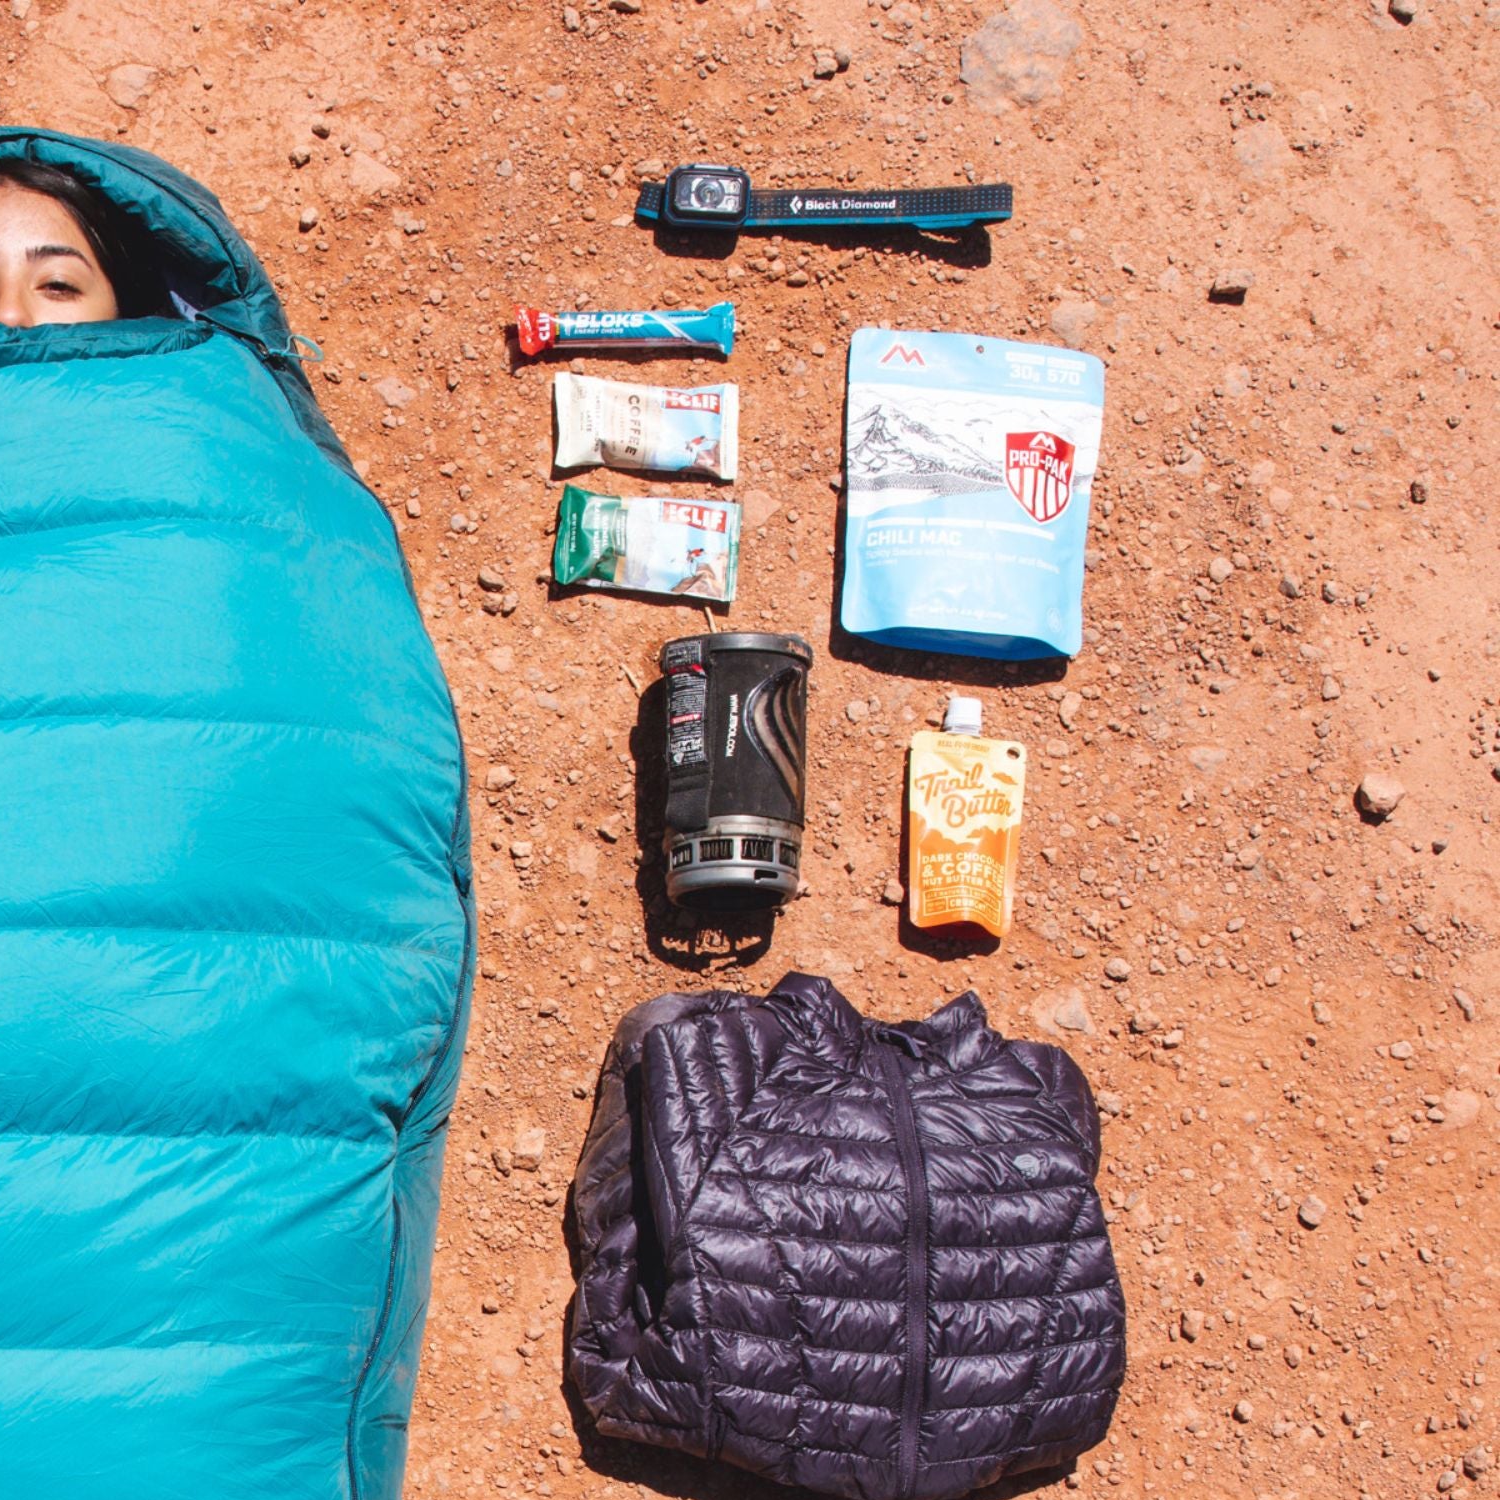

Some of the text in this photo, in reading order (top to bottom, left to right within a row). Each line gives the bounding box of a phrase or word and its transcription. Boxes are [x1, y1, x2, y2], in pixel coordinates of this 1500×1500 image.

[805, 199, 896, 210] Black Diamond
[574, 313, 645, 328] BLOKS
[1046, 367, 1080, 385] 570
[679, 394, 718, 410] CLIF
[625, 394, 642, 456] COFFEE
[1008, 449, 1070, 484] PRO-PAK
[677, 505, 723, 531] CLIF
[866, 529, 962, 547] CHILI MAC
[914, 762, 985, 807] Trail
[941, 789, 1016, 828] Butter
[921, 852, 953, 864] DARK
[922, 861, 1004, 889] & COFFEE
[922, 876, 943, 886] NUT
[946, 873, 984, 887] BUTTER
